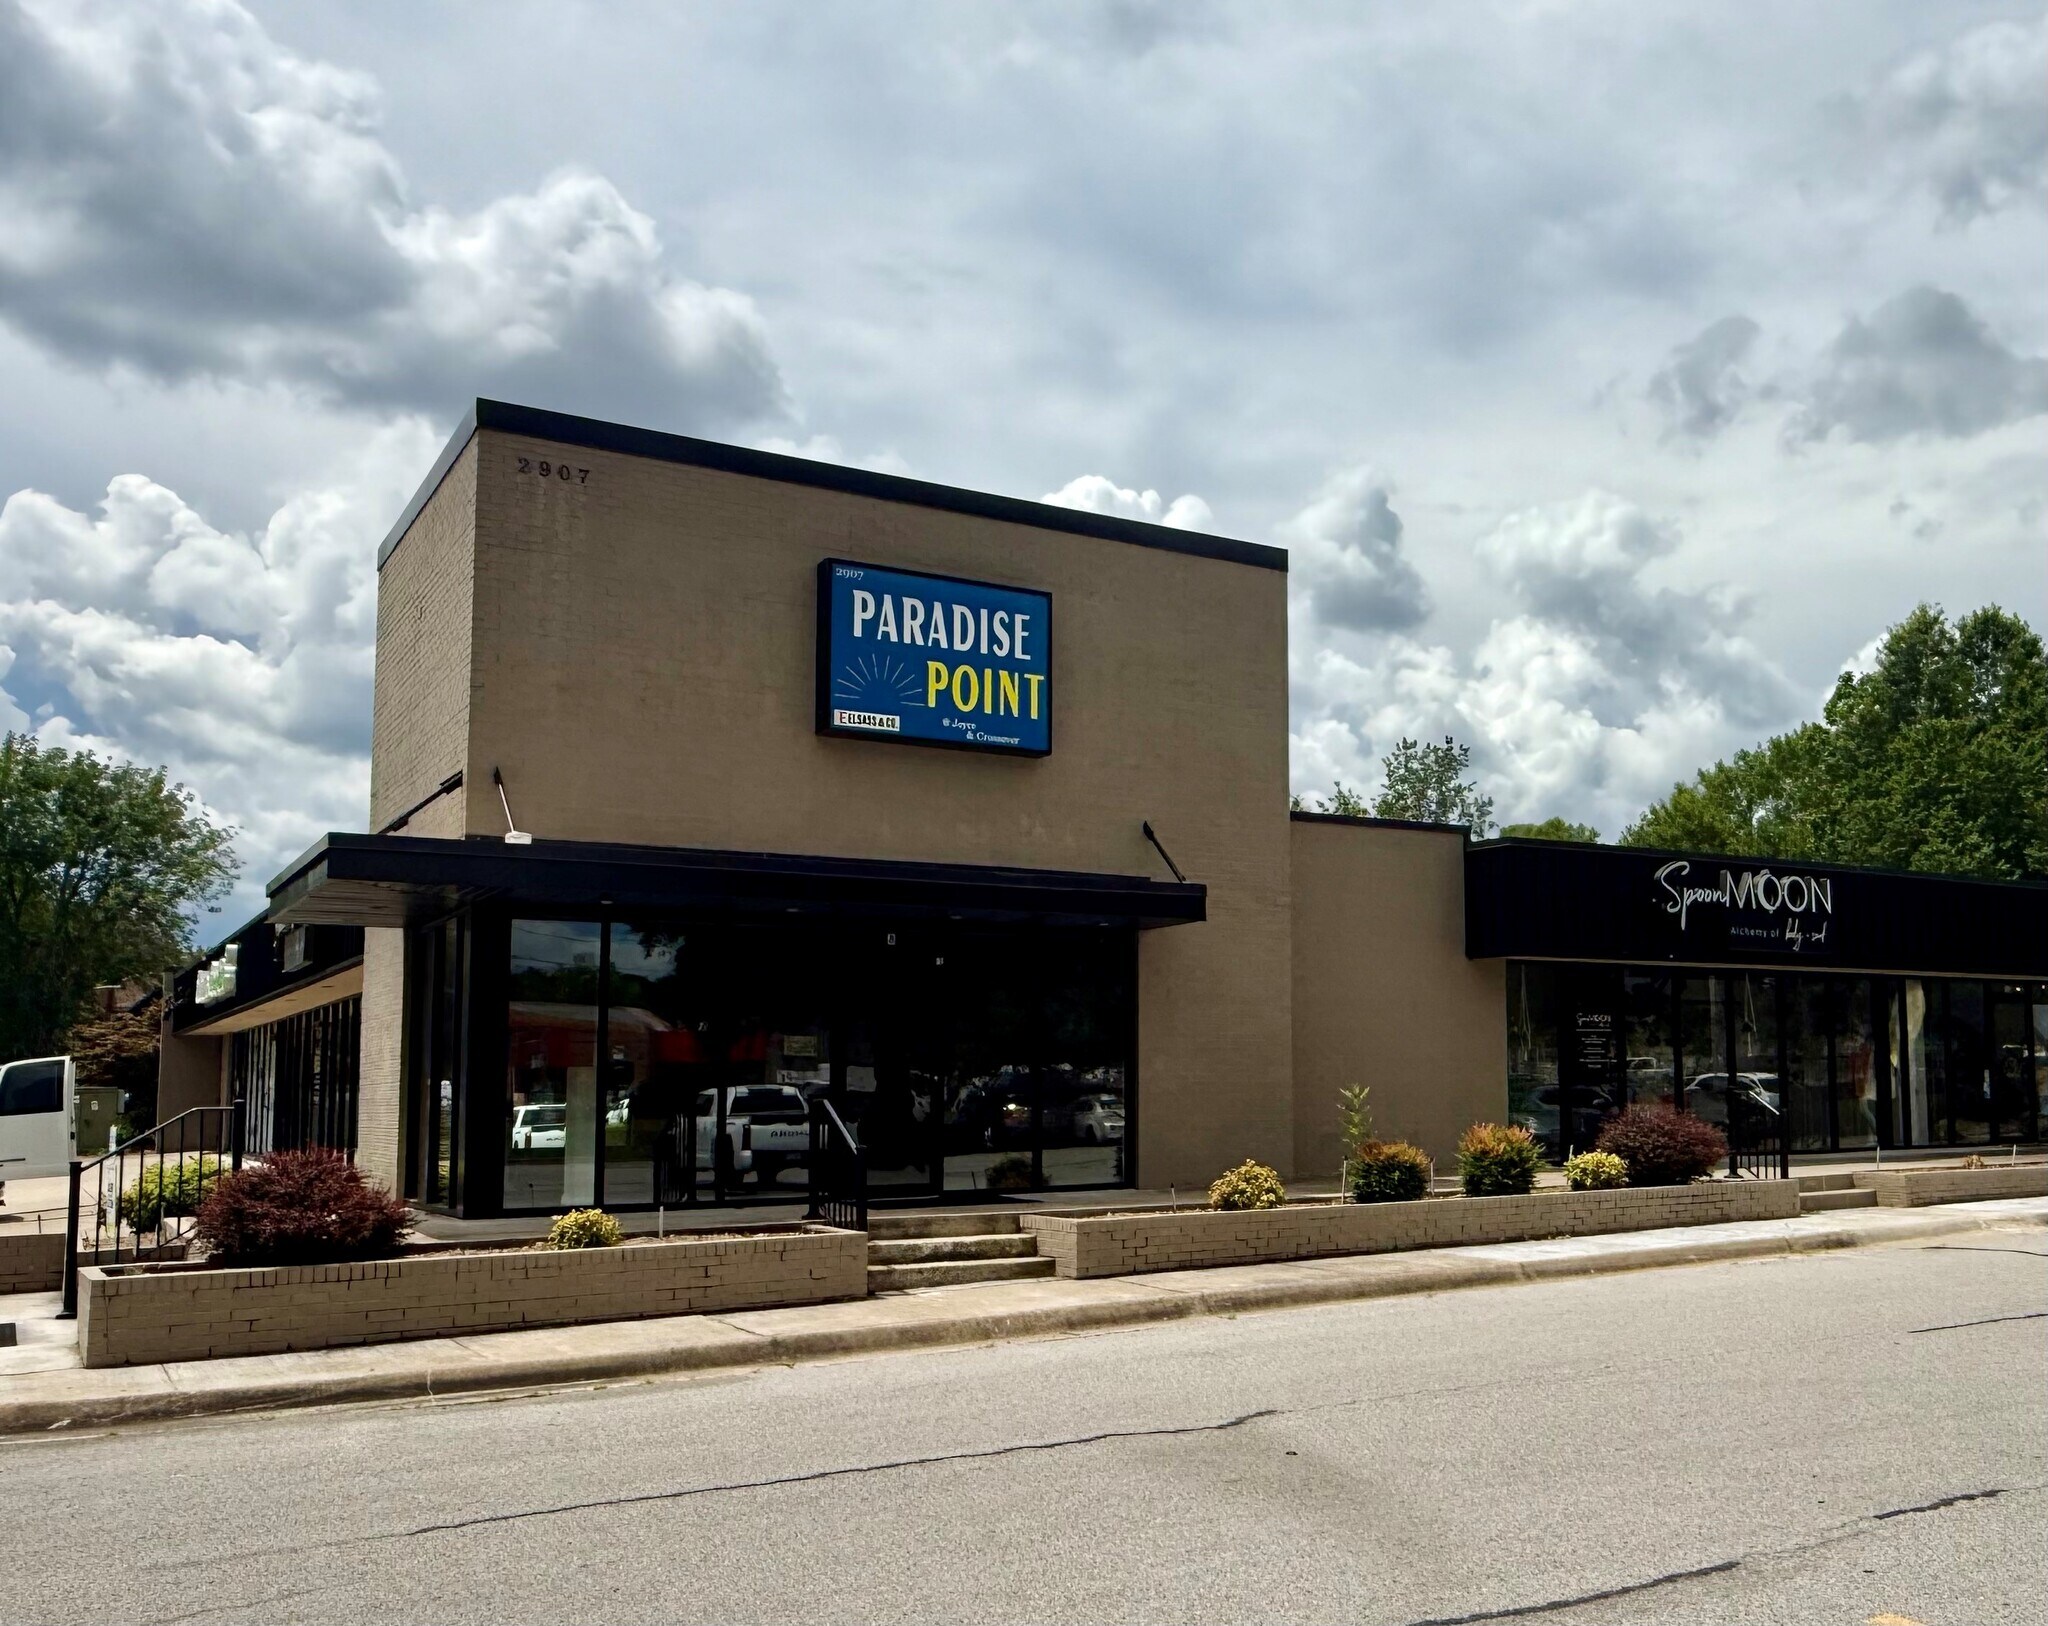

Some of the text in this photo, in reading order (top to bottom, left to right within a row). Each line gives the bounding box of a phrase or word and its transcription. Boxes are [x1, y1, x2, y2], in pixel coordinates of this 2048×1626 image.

[518, 457, 590, 484] 2907
[835, 567, 864, 580] 2907
[852, 589, 1031, 661] PARADISE
[926, 660, 1045, 720] POINT
